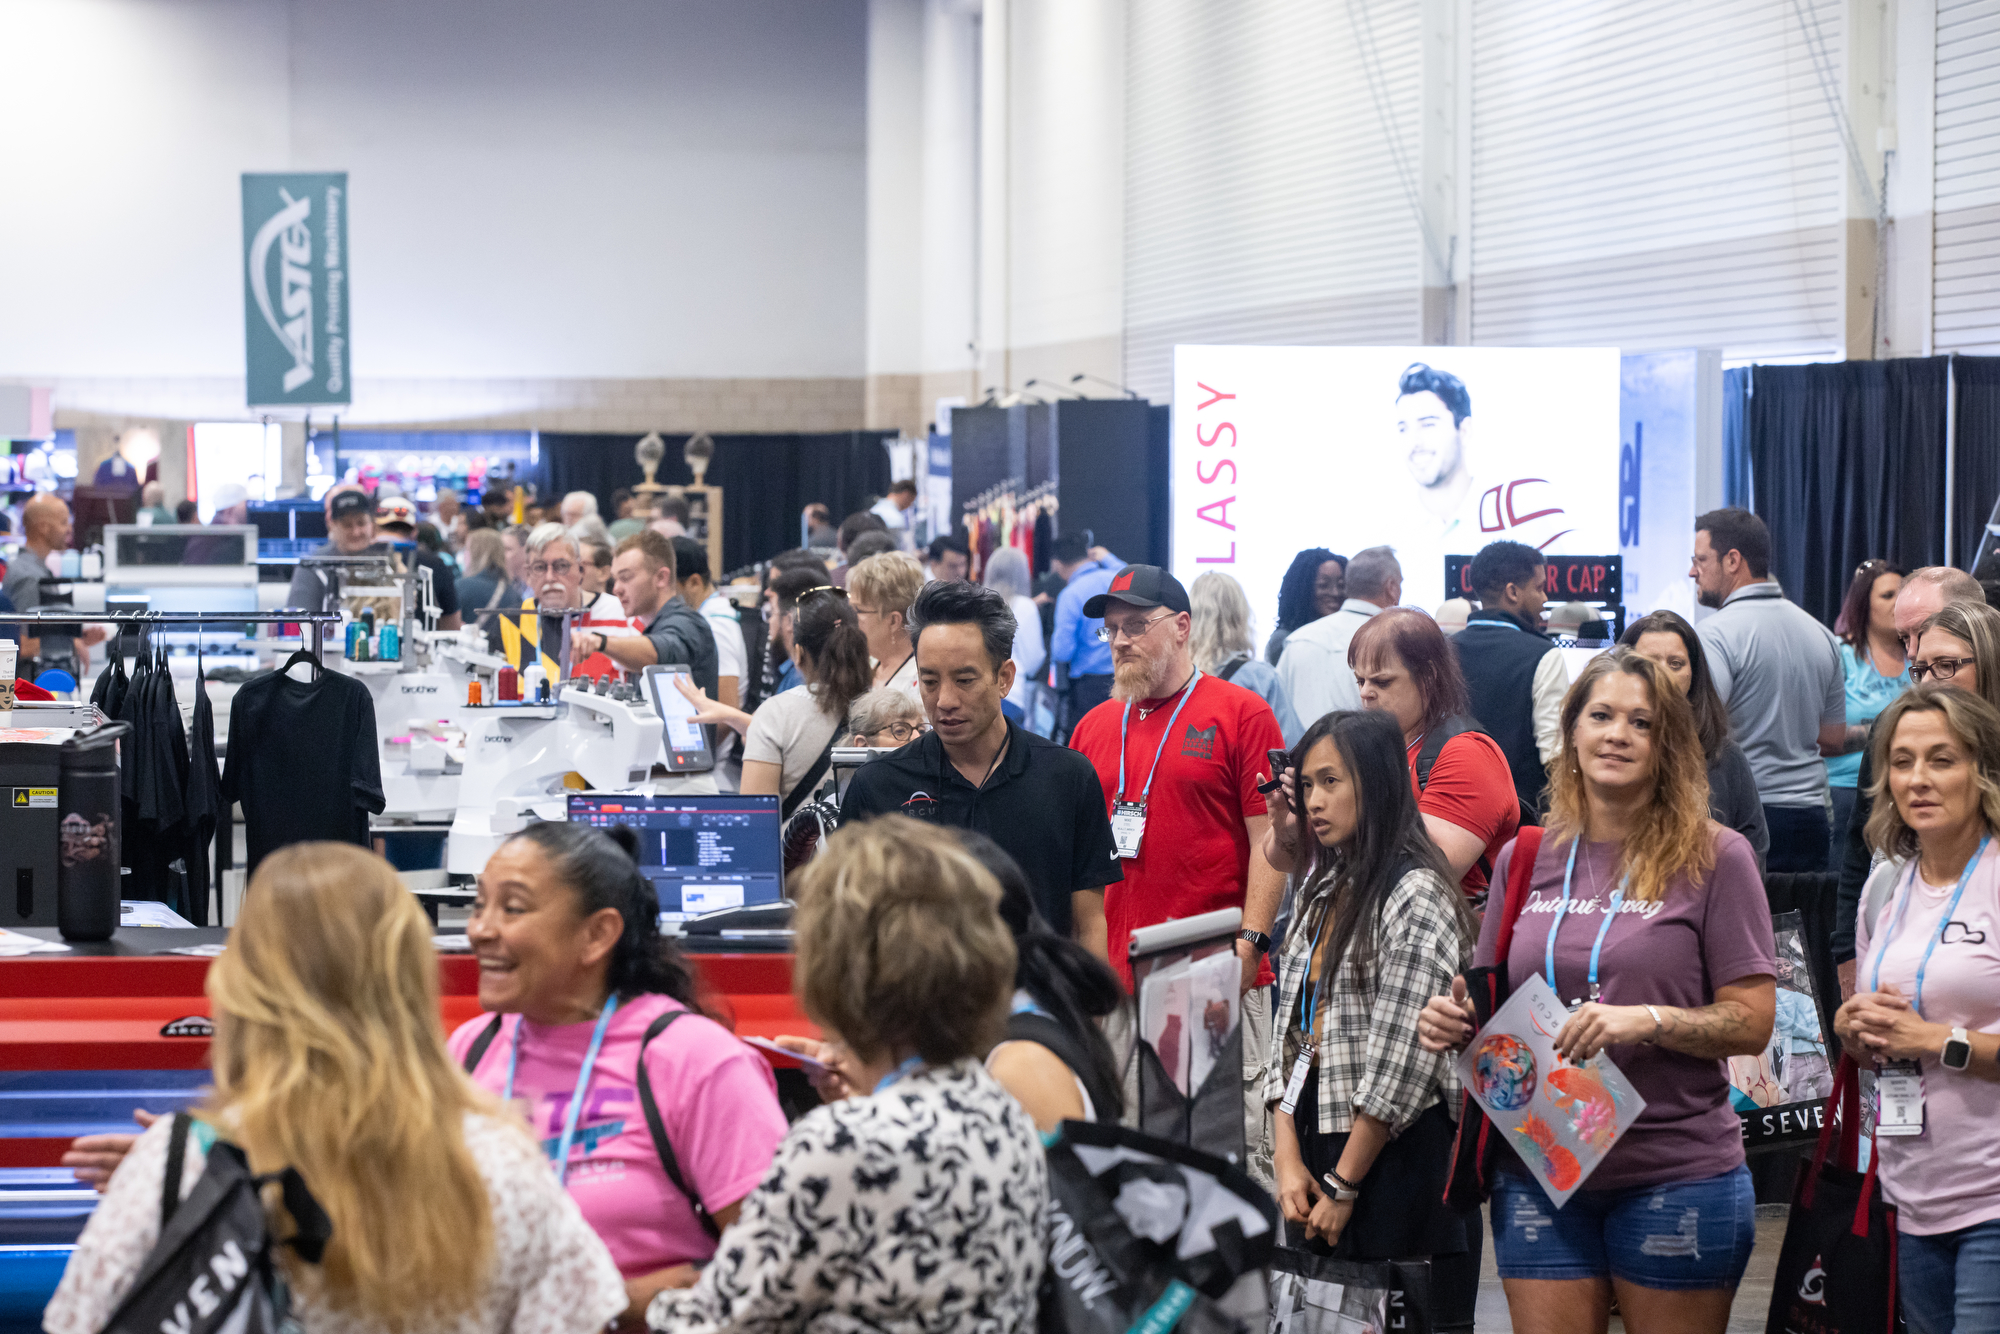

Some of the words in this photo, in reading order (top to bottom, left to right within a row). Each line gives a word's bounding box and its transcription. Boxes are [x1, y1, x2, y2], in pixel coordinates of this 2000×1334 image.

[251, 187, 314, 393] VASTEX
[1196, 381, 1237, 563] LASSY
[1567, 564, 1606, 593] CAP
[401, 685, 438, 694] brother
[484, 735, 513, 743] brother
